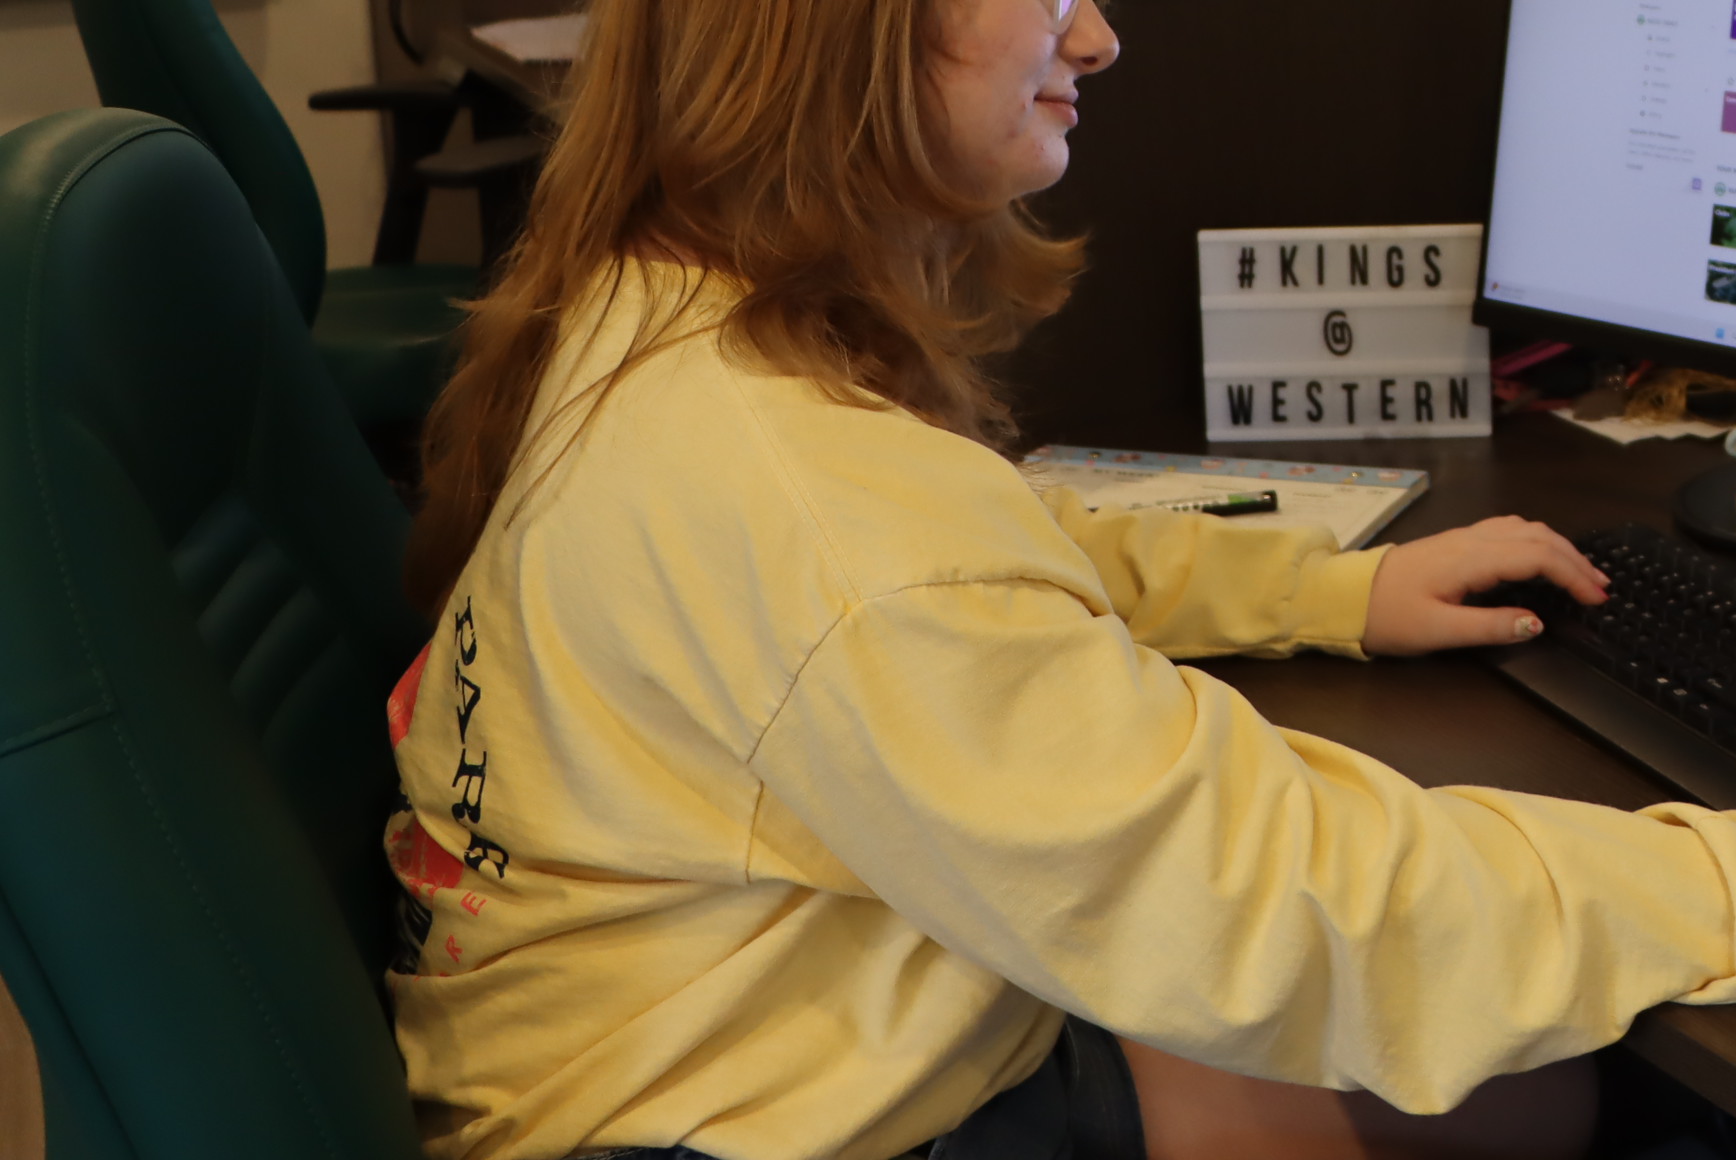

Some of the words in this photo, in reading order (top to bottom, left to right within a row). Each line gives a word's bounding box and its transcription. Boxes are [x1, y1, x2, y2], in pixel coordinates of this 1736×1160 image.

[1237, 244, 1442, 288] #KINGS
[1323, 309, 1354, 357] @
[1227, 377, 1469, 426] WESTERN
